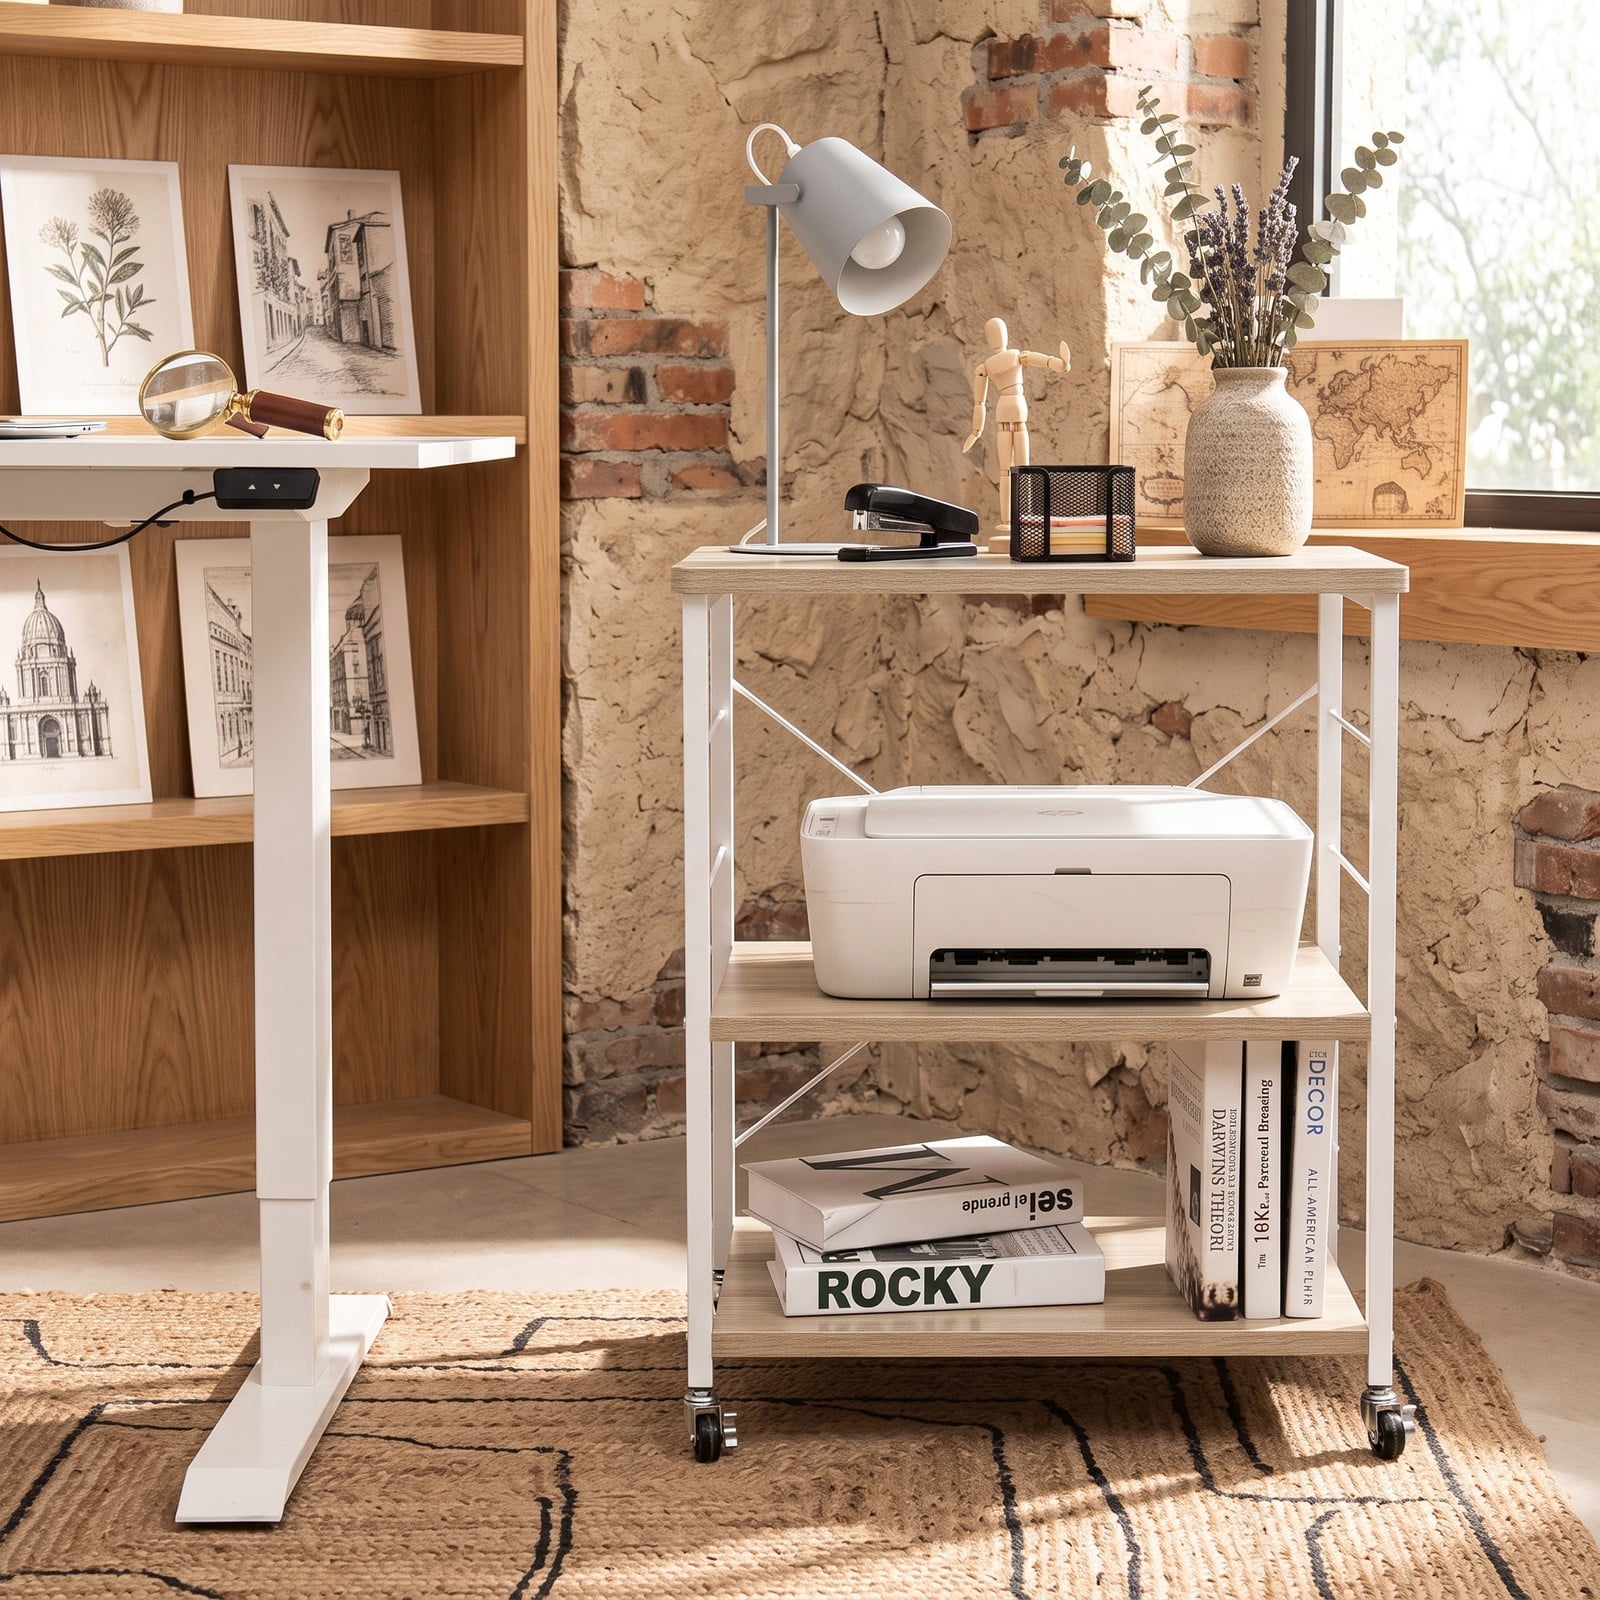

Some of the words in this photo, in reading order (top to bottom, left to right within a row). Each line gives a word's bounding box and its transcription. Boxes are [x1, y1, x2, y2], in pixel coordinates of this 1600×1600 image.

[1306, 1060, 1326, 1135] DECOR
[1210, 1108, 1226, 1186] DARWINS
[1030, 1188, 1073, 1221] sei
[1210, 1190, 1225, 1251] THEORI
[818, 1264, 994, 1309] ROCKY
